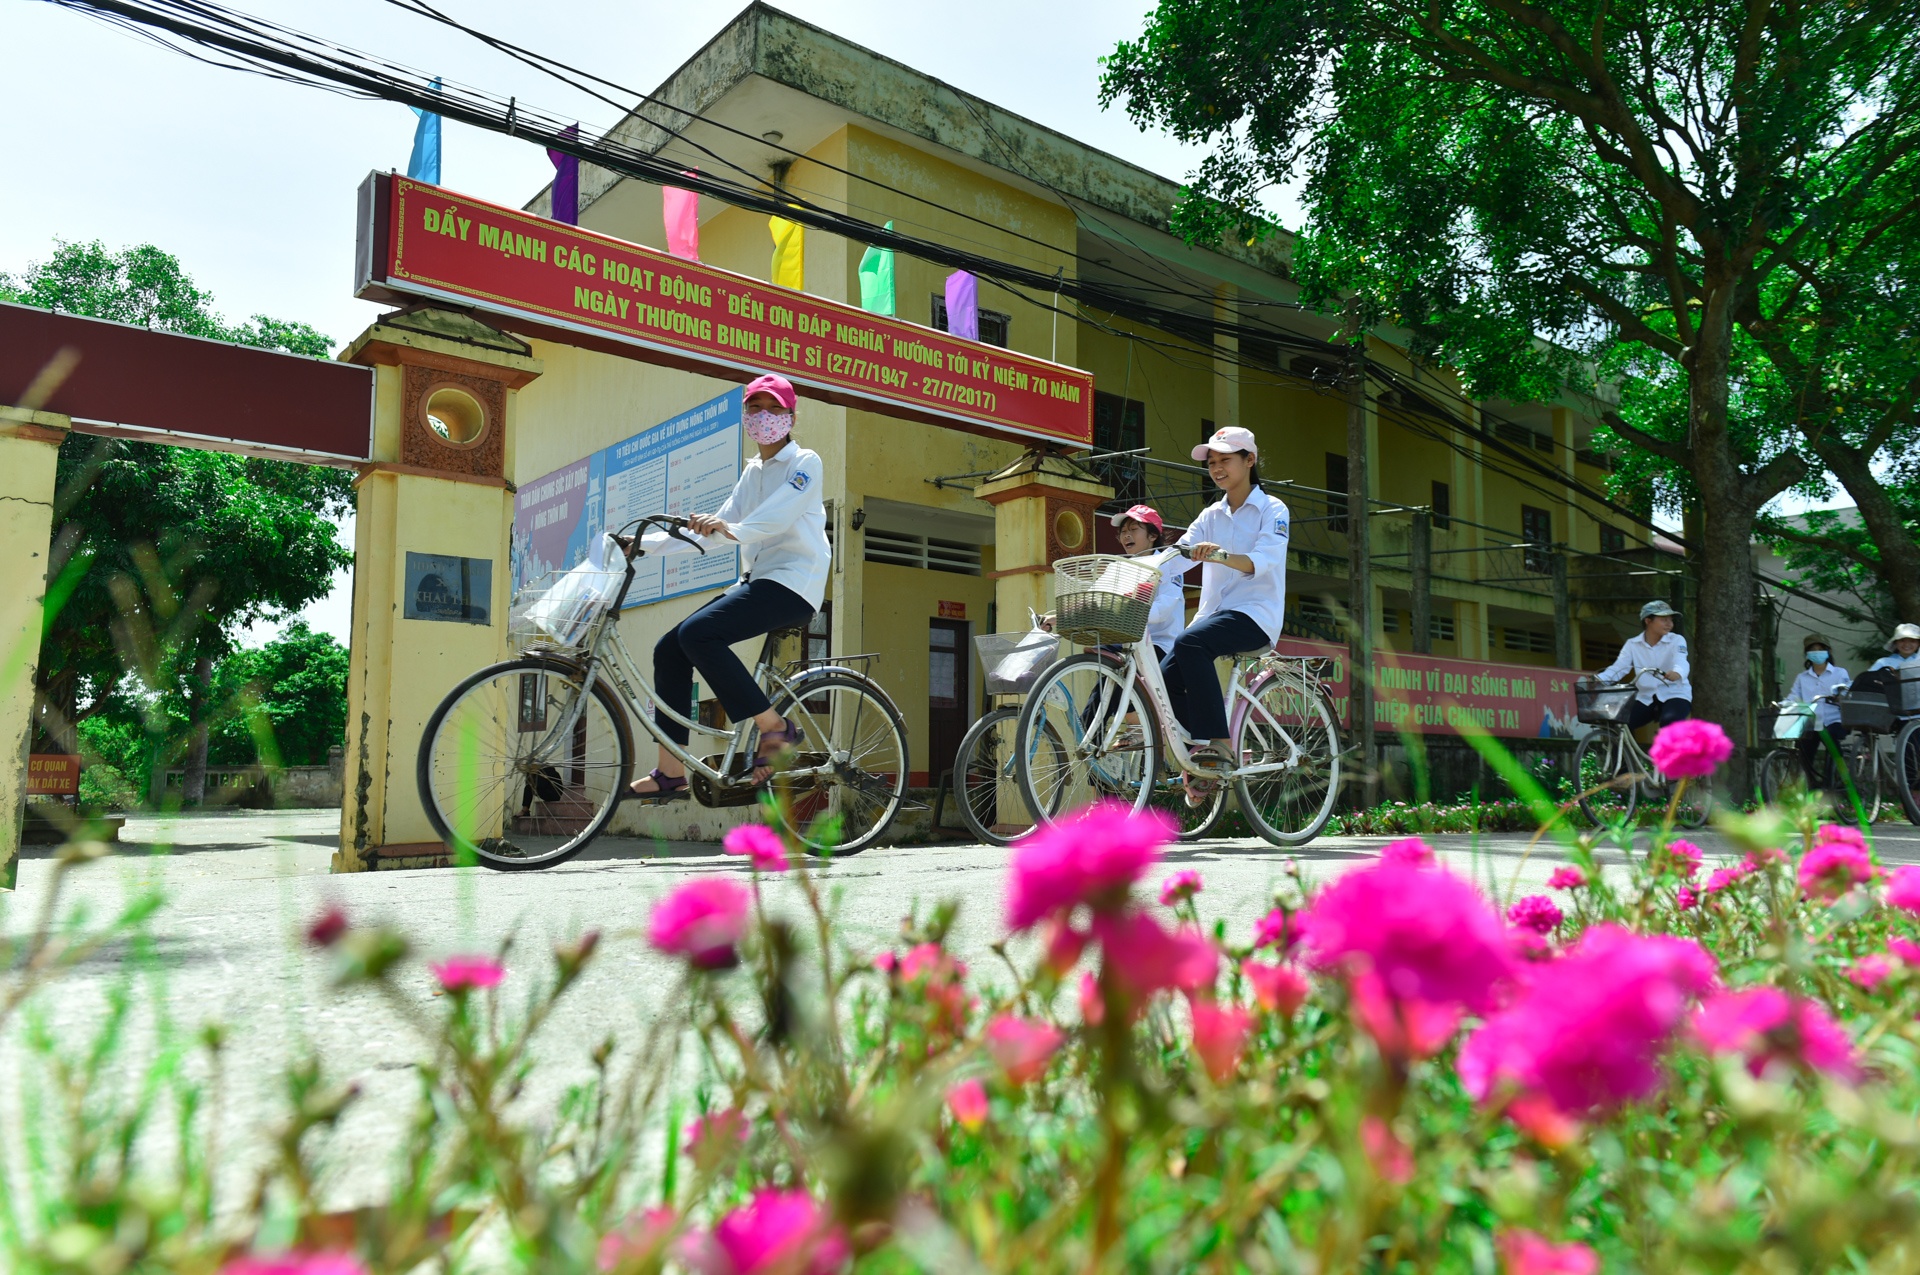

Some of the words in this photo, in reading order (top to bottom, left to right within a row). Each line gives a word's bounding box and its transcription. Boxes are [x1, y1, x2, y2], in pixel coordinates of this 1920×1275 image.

[423, 206, 471, 241] ĐẨY
[479, 223, 546, 262] MẠNH
[553, 245, 596, 275] CÁC
[602, 258, 654, 293] HOẠT
[659, 275, 711, 308] ĐỘNG
[769, 305, 793, 329] ƠN
[798, 313, 832, 338] ĐÁP
[893, 339, 943, 369] HƯỚNG
[947, 351, 968, 376] TỚI
[972, 356, 990, 381] KỶ
[994, 366, 1028, 391] NIỆM
[1031, 376, 1047, 396] 70
[1050, 380, 1080, 403] NĂM
[574, 286, 630, 319] NGÀY
[636, 302, 712, 341] THƯƠNG
[717, 324, 760, 353] BINH
[766, 337, 800, 364] LIỆT
[805, 345, 822, 368] SĨ
[827, 352, 908, 389] (27/7/1947
[922, 376, 996, 412] 27/7/2017)
[1381, 666, 1422, 691] MINH
[1425, 668, 1441, 692] VĨ
[1443, 673, 1468, 698] ĐẠI
[1471, 670, 1508, 698] SỐNG
[1511, 676, 1536, 699] MÃI
[1374, 698, 1410, 728] HIỆP
[1414, 696, 1444, 726] CỦA
[1448, 704, 1495, 728] CHÚNG
[1498, 709, 1520, 729] TA!
[44, 760, 67, 772] QUAN
[60, 778, 71, 788] XE
